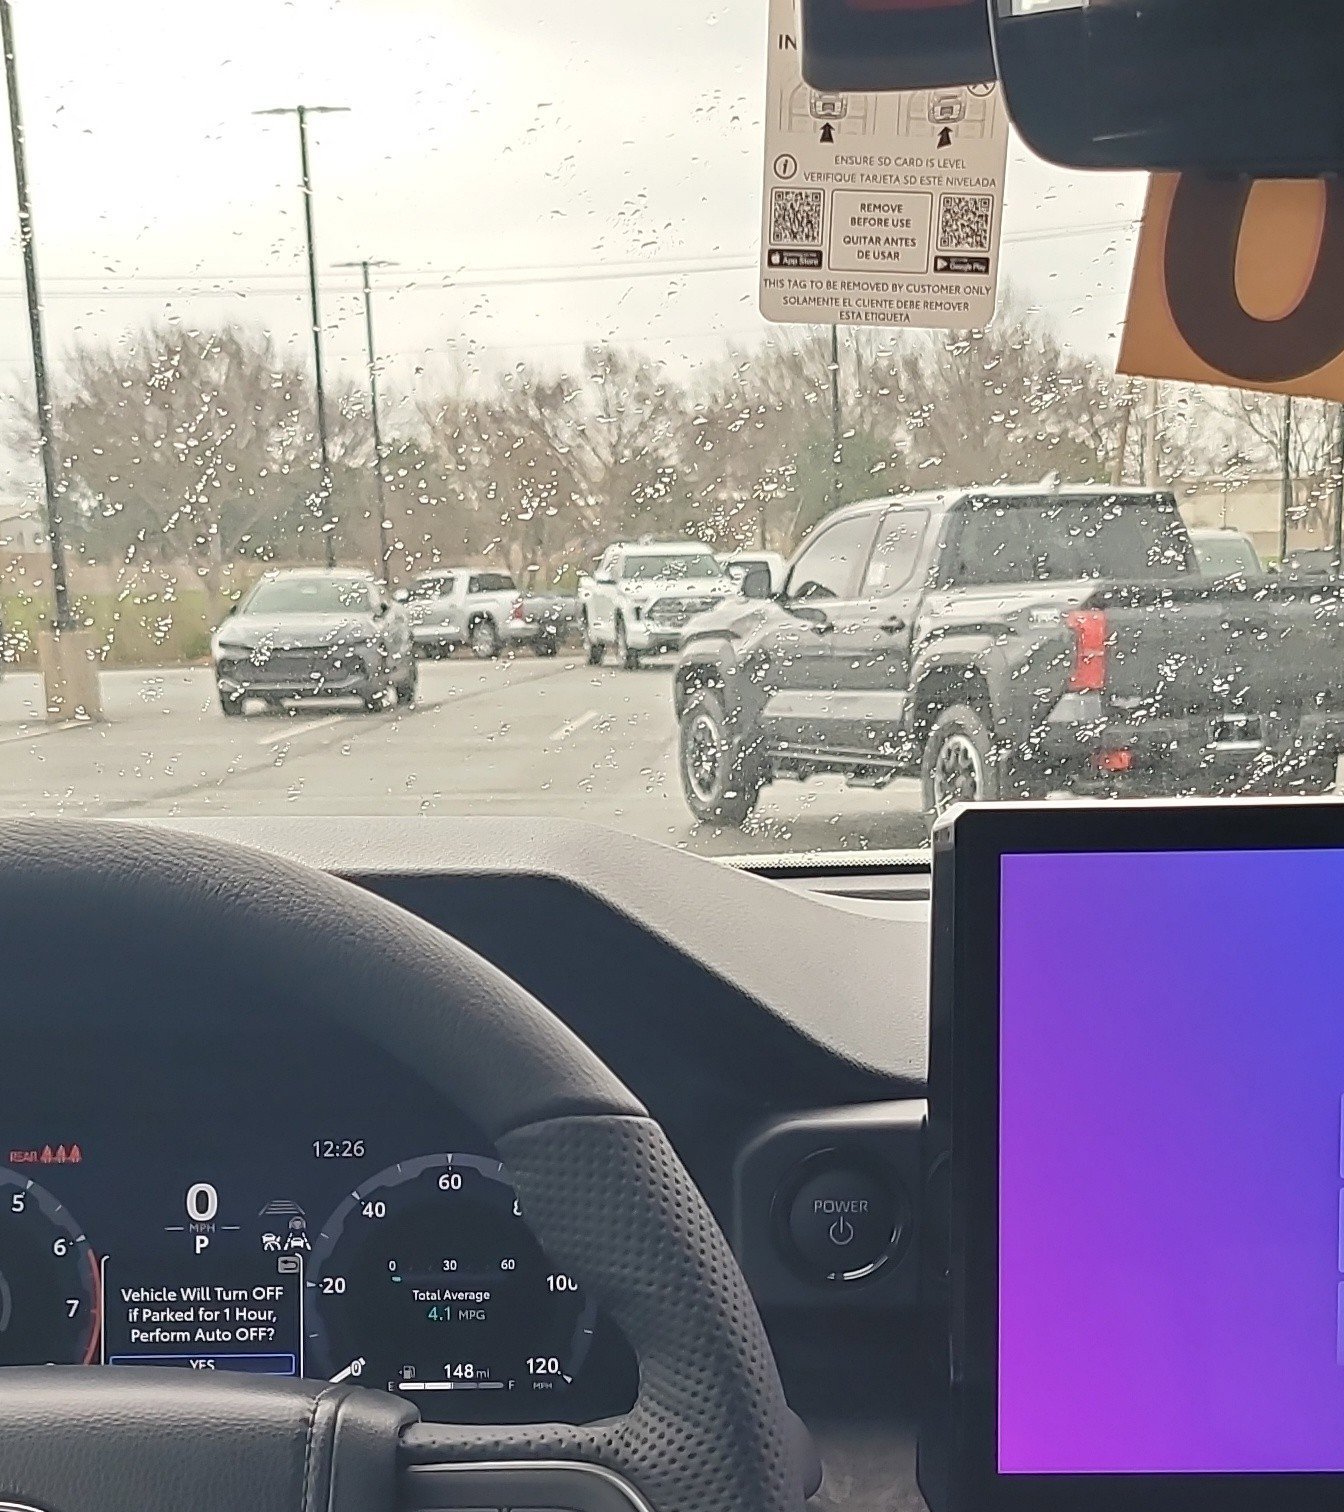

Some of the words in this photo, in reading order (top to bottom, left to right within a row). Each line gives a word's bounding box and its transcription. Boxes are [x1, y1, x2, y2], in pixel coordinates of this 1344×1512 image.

[834, 155, 875, 167] ENSURE
[877, 156, 892, 167] SD
[894, 157, 923, 168] CARD
[926, 158, 935, 168] IS
[937, 158, 966, 170] LEVEL
[803, 171, 857, 184] VERIFIQUE
[859, 173, 901, 185] TARJETA
[903, 175, 917, 185] SD
[919, 175, 943, 187] ESTE
[945, 176, 996, 188] NIVELADA
[860, 203, 903, 213] REMOVE
[850, 216, 890, 228] BEFORE
[891, 218, 912, 228] USE
[843, 235, 881, 246] QUITAR
[883, 237, 917, 248] ANTES
[857, 249, 870, 260] DE
[873, 250, 900, 261] USAR
[763, 278, 785, 290] THIS
[787, 279, 807, 290] TAG
[810, 280, 824, 290] TO
[825, 280, 838, 291] BE
[840, 281, 889, 293] REMOVED
[891, 282, 905, 293] BY
[906, 283, 961, 295] CUSTOMER
[963, 285, 992, 296] ONLY
[782, 296, 840, 308] SOLAMENTE
[842, 298, 853, 307] EL
[855, 298, 894, 309] CLIENTE
[896, 299, 922, 310] DEBE
[923, 300, 969, 312] REMOVER
[839, 311, 863, 321] ESTA
[864, 311, 911, 323] ETIQUETA
[312, 1139, 365, 1158] 12:26
[437, 1174, 462, 1190] 60
[11, 1194, 26, 1213] 5
[185, 1182, 219, 1222] 0
[361, 1201, 386, 1218] 40
[814, 1199, 869, 1214] POWER
[189, 1223, 216, 1234] MPH
[53, 1238, 67, 1256] 6
[195, 1235, 210, 1254] P
[388, 1260, 397, 1271] 0
[442, 1259, 457, 1271] 30
[500, 1259, 515, 1271] 60
[322, 1277, 346, 1294] 20
[121, 1287, 177, 1302] Vehicle
[180, 1287, 211, 1302] Will
[214, 1287, 248, 1301] Turn
[252, 1286, 284, 1301] OFF
[412, 1289, 442, 1301] Total
[442, 1289, 490, 1303] Average
[65, 1300, 80, 1318] 7
[128, 1307, 139, 1322] if
[142, 1307, 194, 1322] Parked
[198, 1307, 220, 1322] for
[223, 1307, 230, 1321] 1
[235, 1306, 278, 1324] Hour,
[427, 1306, 452, 1321] 4.1
[458, 1309, 486, 1321] MPG
[131, 1328, 191, 1343] Perform
[194, 1328, 232, 1342] Auto
[235, 1327, 276, 1342] OFF?
[189, 1359, 215, 1371] YES
[444, 1363, 474, 1379] 148
[476, 1367, 490, 1378] mi
[526, 1357, 558, 1374] 120
[388, 1381, 395, 1392] E
[508, 1380, 515, 1390] F
